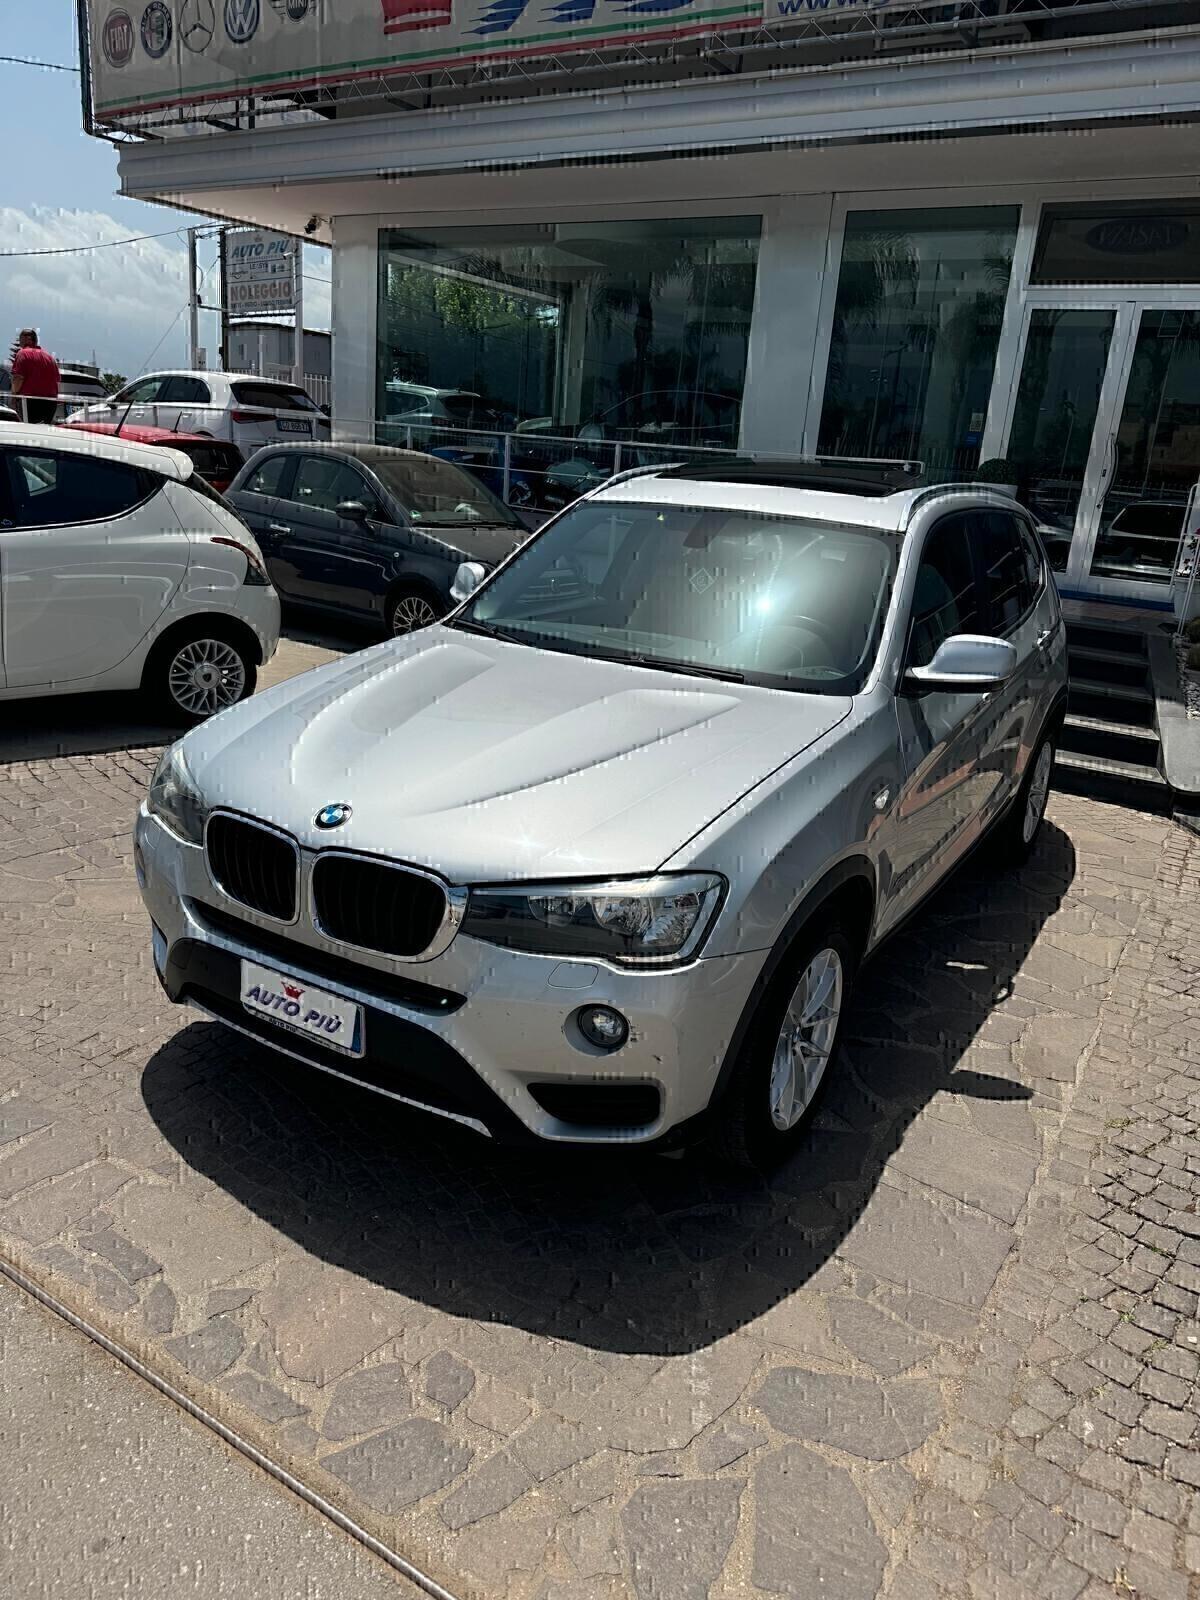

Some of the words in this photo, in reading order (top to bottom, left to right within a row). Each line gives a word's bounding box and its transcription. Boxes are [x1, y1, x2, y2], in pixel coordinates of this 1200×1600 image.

[109, 24, 128, 51] FIAT
[231, 243, 265, 258] AUTO
[230, 281, 292, 301] NOLEGGIO
[245, 986, 301, 1017] AUTO
[303, 1009, 342, 1033] PIÙ
